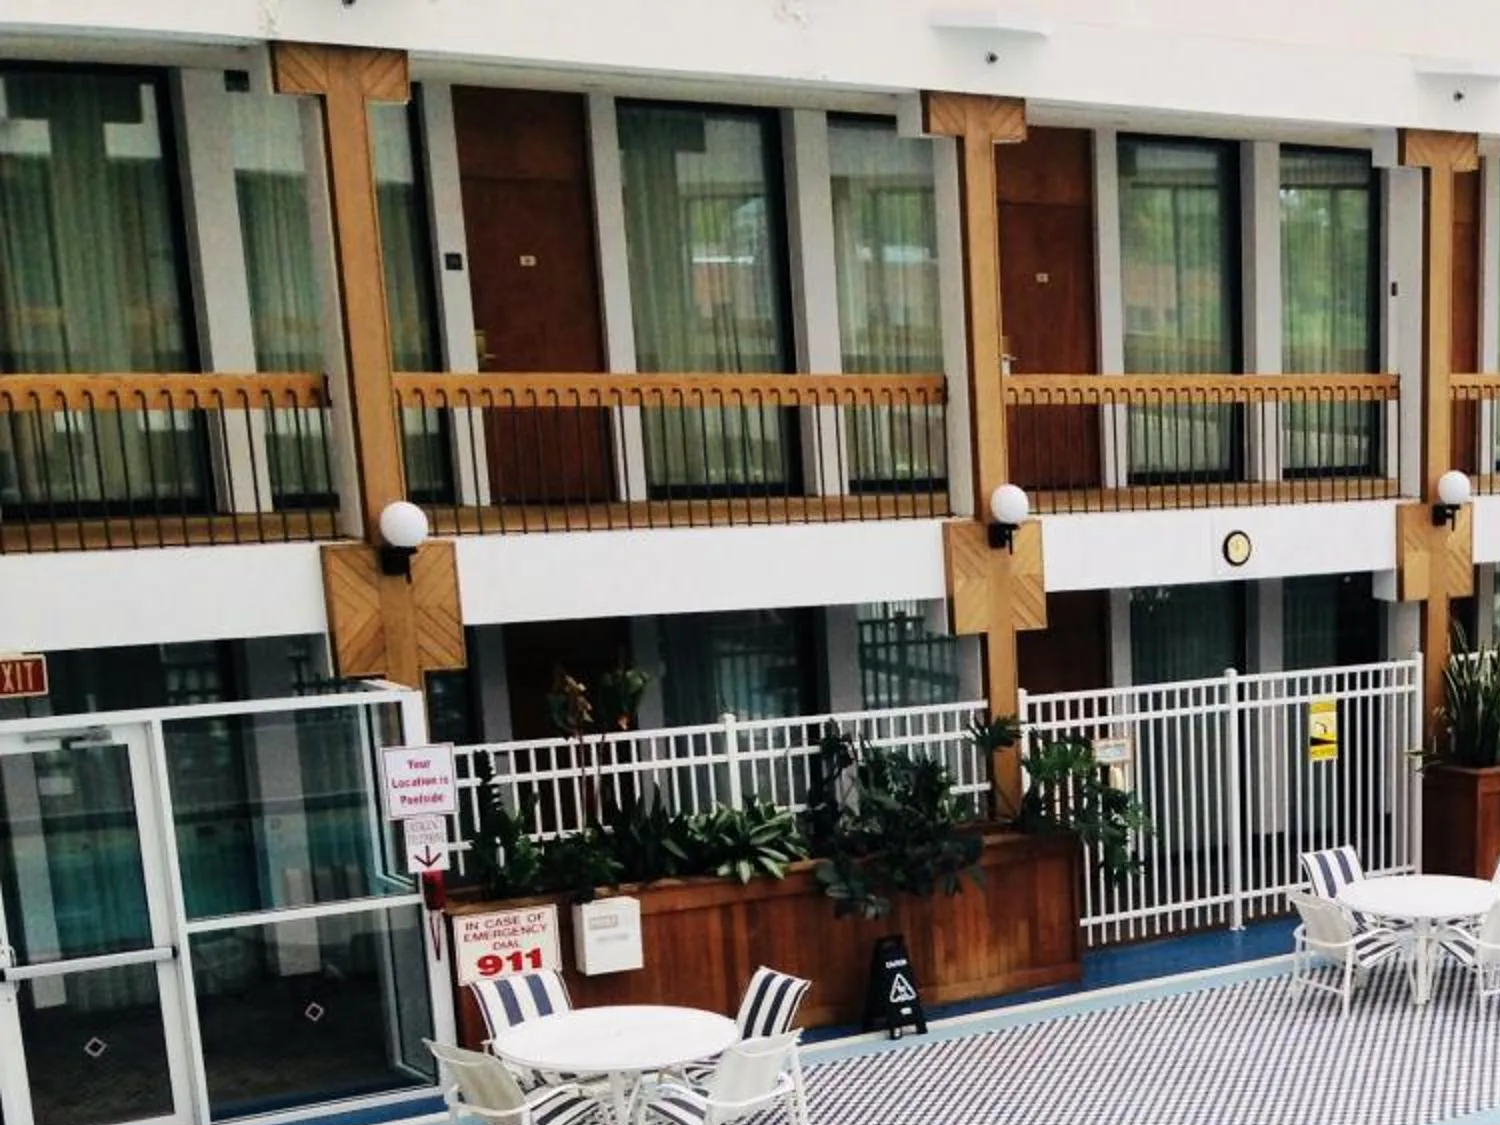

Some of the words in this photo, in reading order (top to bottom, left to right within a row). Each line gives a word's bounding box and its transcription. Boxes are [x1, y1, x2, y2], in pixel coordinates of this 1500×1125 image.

[0, 662, 34, 692] XIT
[391, 776, 438, 789] Location
[465, 921, 480, 931] IN
[484, 915, 519, 929] CASE
[527, 911, 545, 923] OF
[463, 923, 546, 942] EMERGENCY
[493, 940, 519, 950] DIAL
[477, 947, 543, 976] 911
